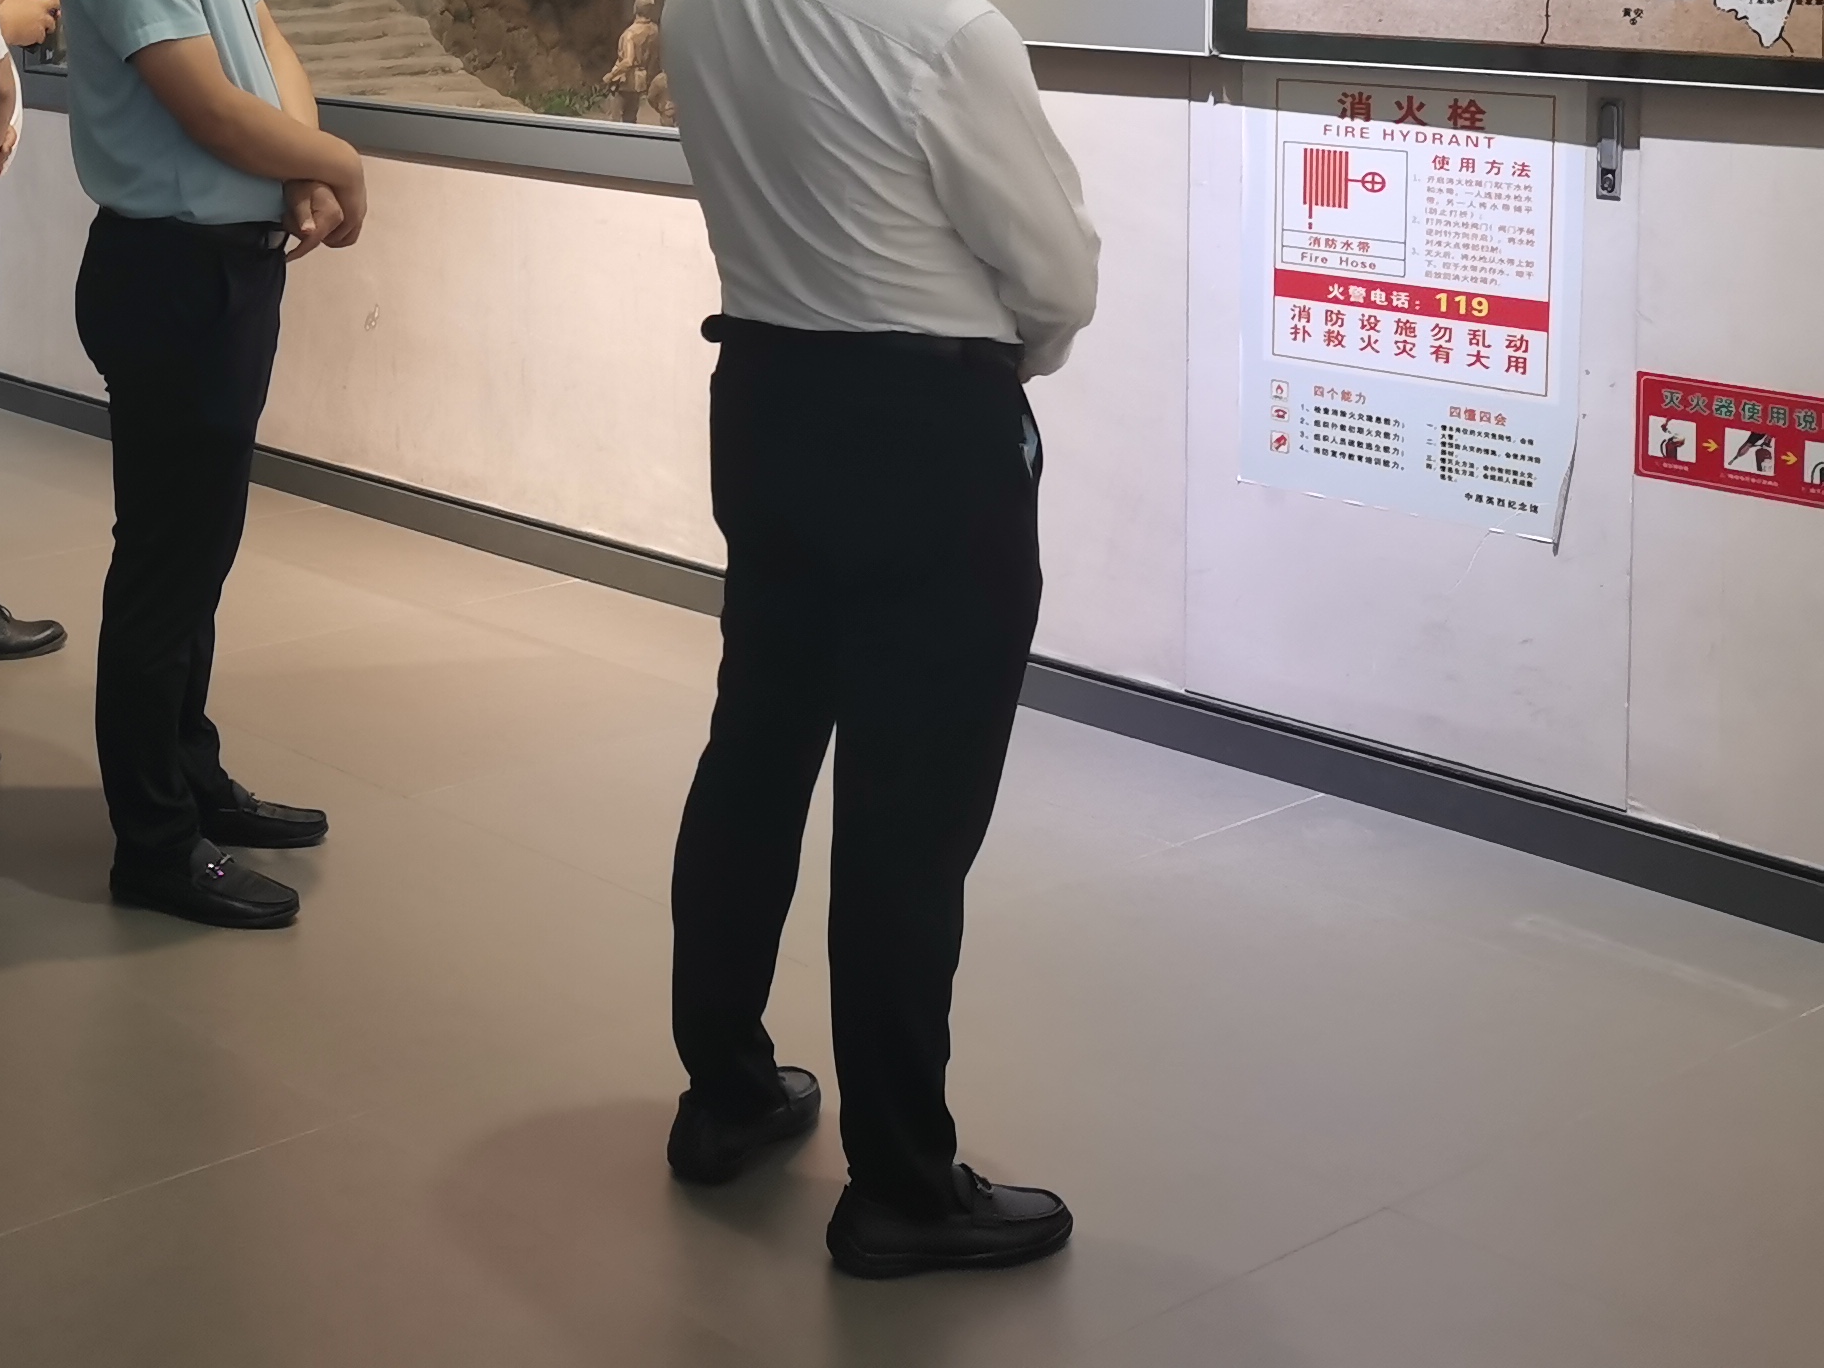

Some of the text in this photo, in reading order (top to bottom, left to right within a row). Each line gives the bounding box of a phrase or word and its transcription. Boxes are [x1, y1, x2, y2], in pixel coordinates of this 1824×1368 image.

[1337, 91, 1487, 131] 消火栓
[1323, 124, 1496, 150] FIRE HYDRANT
[1431, 154, 1532, 179] 使用方法
[1307, 236, 1371, 253] 消防水带
[1300, 251, 1377, 271] Fire Hose
[1327, 283, 1489, 317] 火警电话： 119
[1290, 304, 1530, 354] 消防设施勿乱动
[1290, 324, 1528, 375] 扑救火灾有大用
[1313, 385, 1366, 405] 四个能力
[1661, 389, 1824, 433] 灭火器使用说
